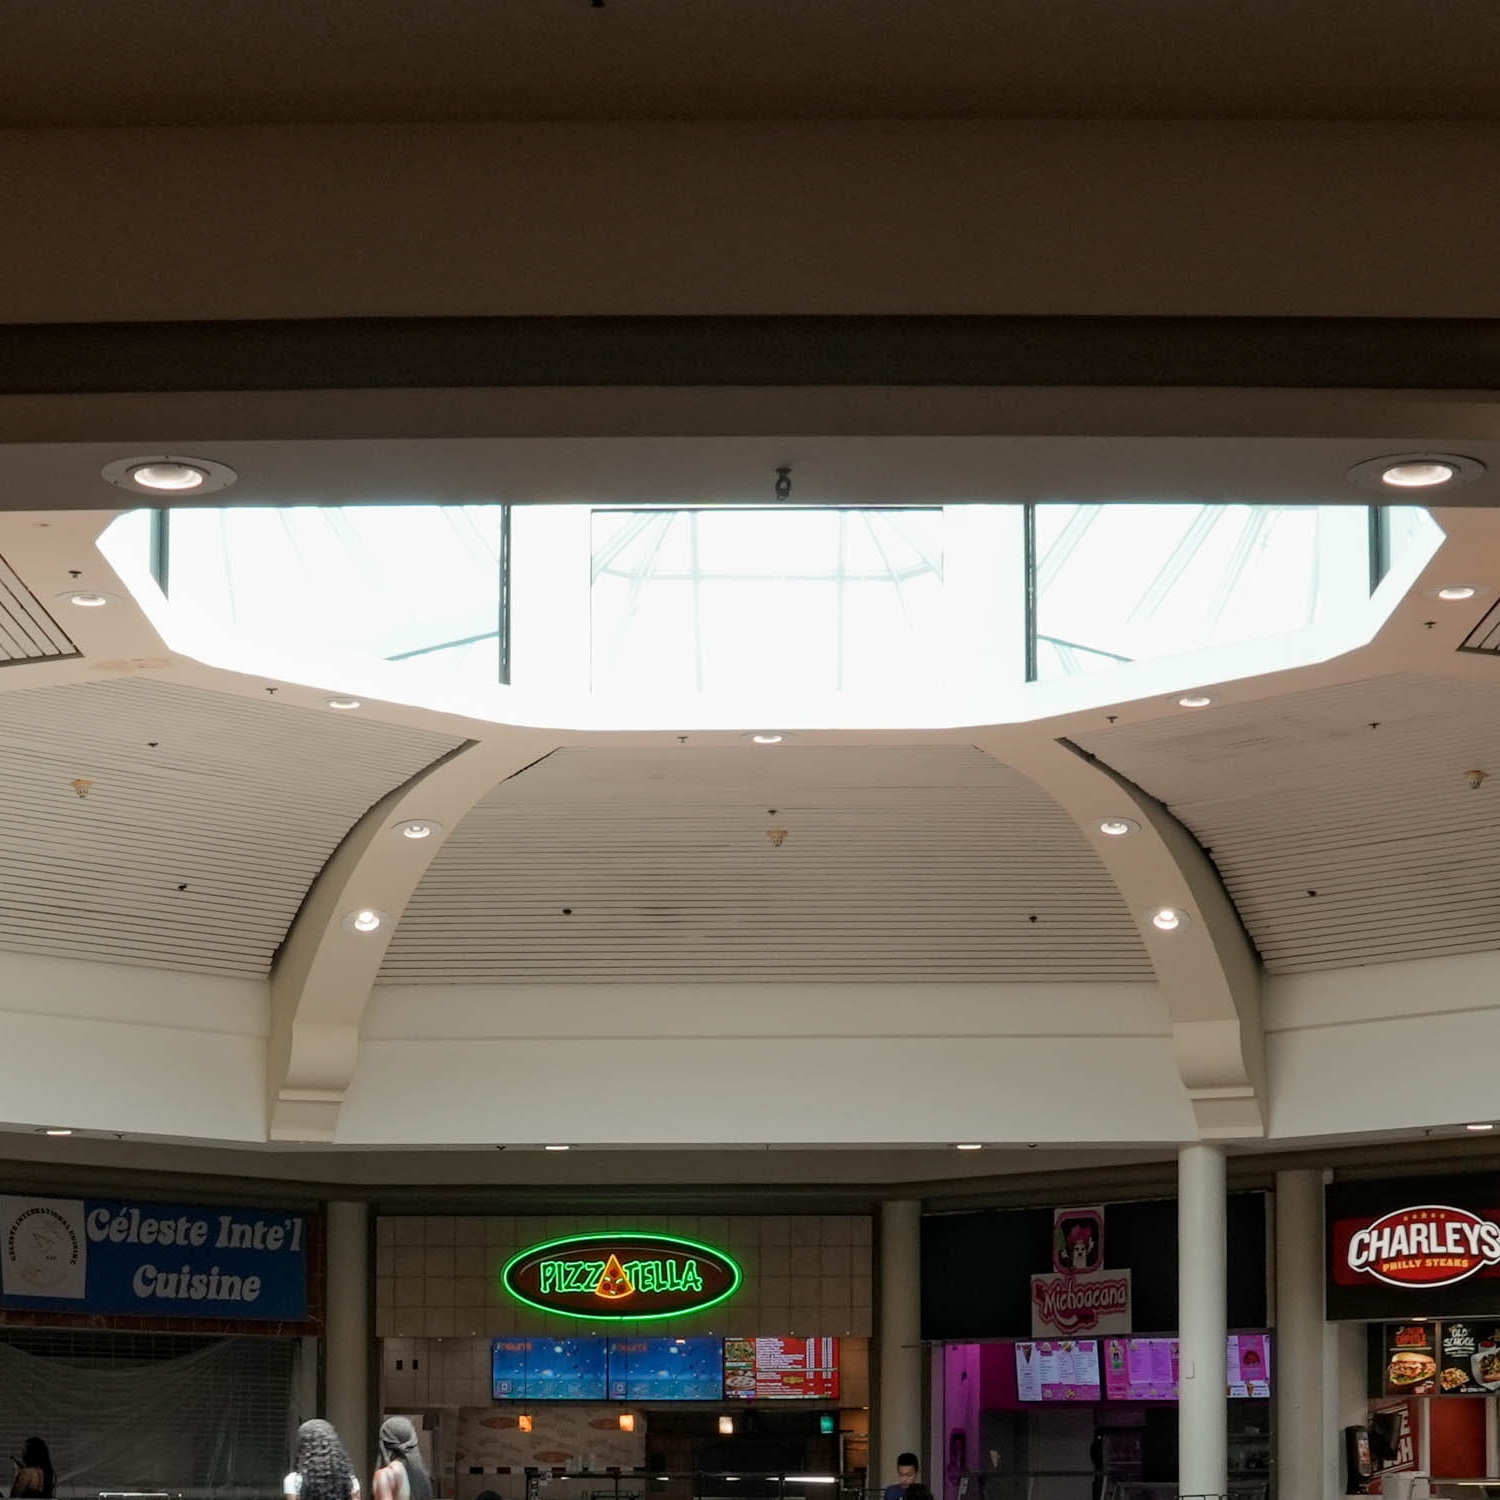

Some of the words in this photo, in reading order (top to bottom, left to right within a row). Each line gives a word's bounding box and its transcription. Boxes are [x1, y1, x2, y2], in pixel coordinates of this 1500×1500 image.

[86, 1207, 208, 1248] Céleste
[215, 1216, 303, 1252] Inte'l
[132, 1263, 262, 1302] Cuisine
[1381, 1259, 1422, 1273] PHILLY
[1424, 1258, 1469, 1269] STEAKS
[1043, 1279, 1127, 1322] Michoacana
[1442, 1337, 1476, 1348] SCHOOL
